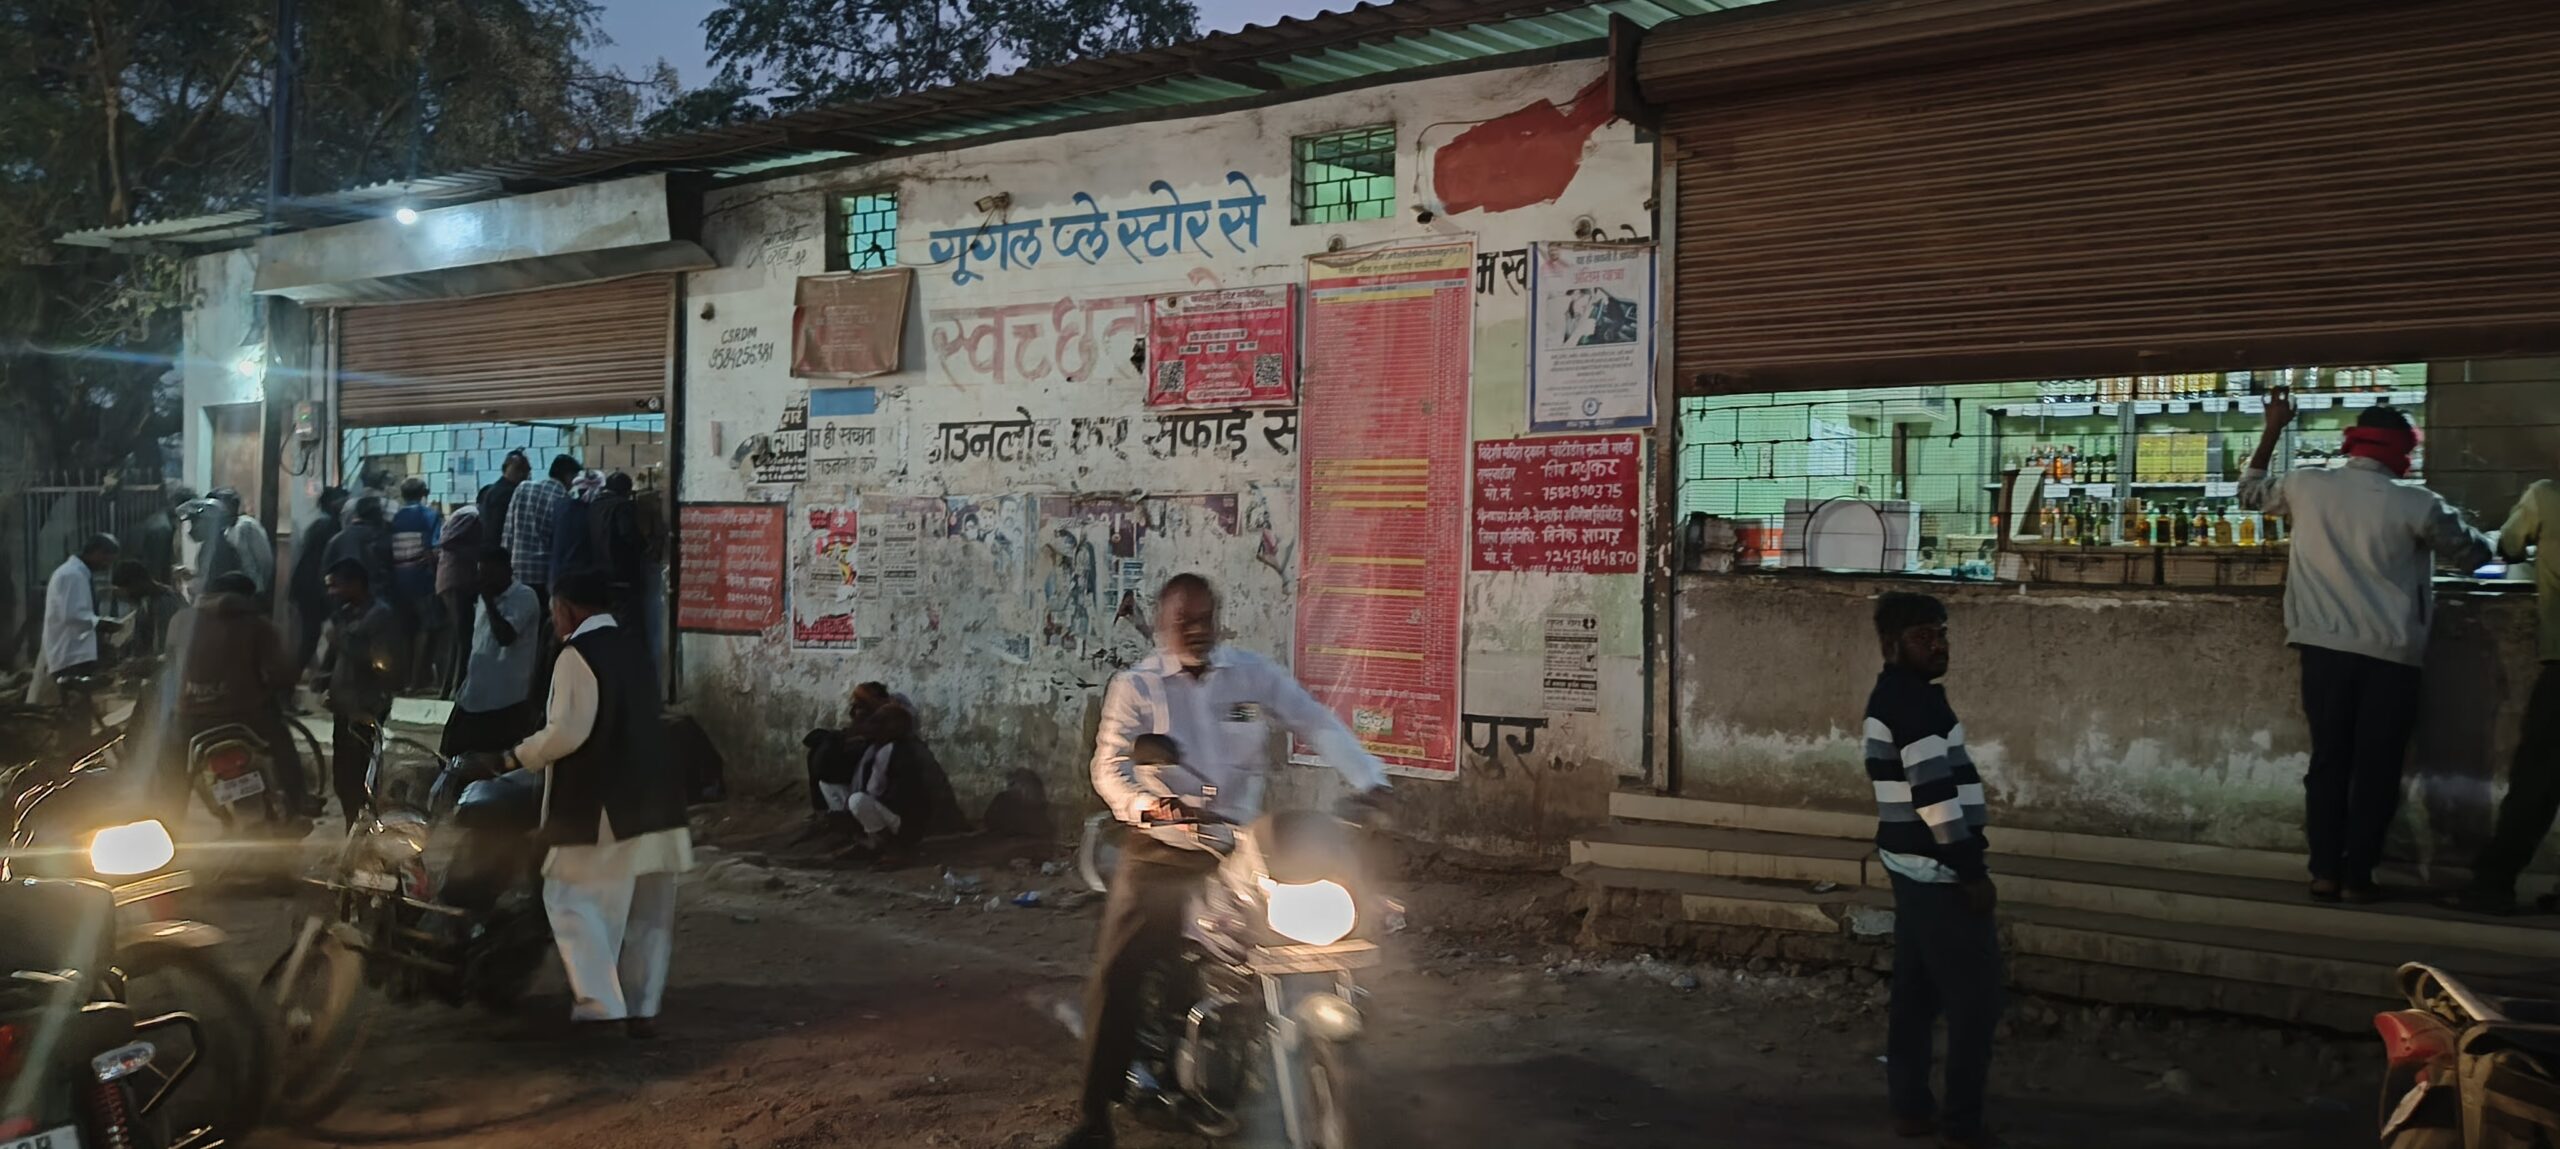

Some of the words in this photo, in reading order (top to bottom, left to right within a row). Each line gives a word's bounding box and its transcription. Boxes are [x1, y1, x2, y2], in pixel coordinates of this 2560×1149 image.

[929, 219, 1043, 286] गूगल
[1050, 191, 1109, 265] प्ले
[1117, 180, 1213, 264] स्टोर
[1218, 171, 1267, 254] से
[1570, 459, 1620, 482] मधुकर
[1541, 483, 1622, 501] 7582890375
[1545, 549, 1636, 567] 9243484870
[1462, 713, 1549, 780] पुर
